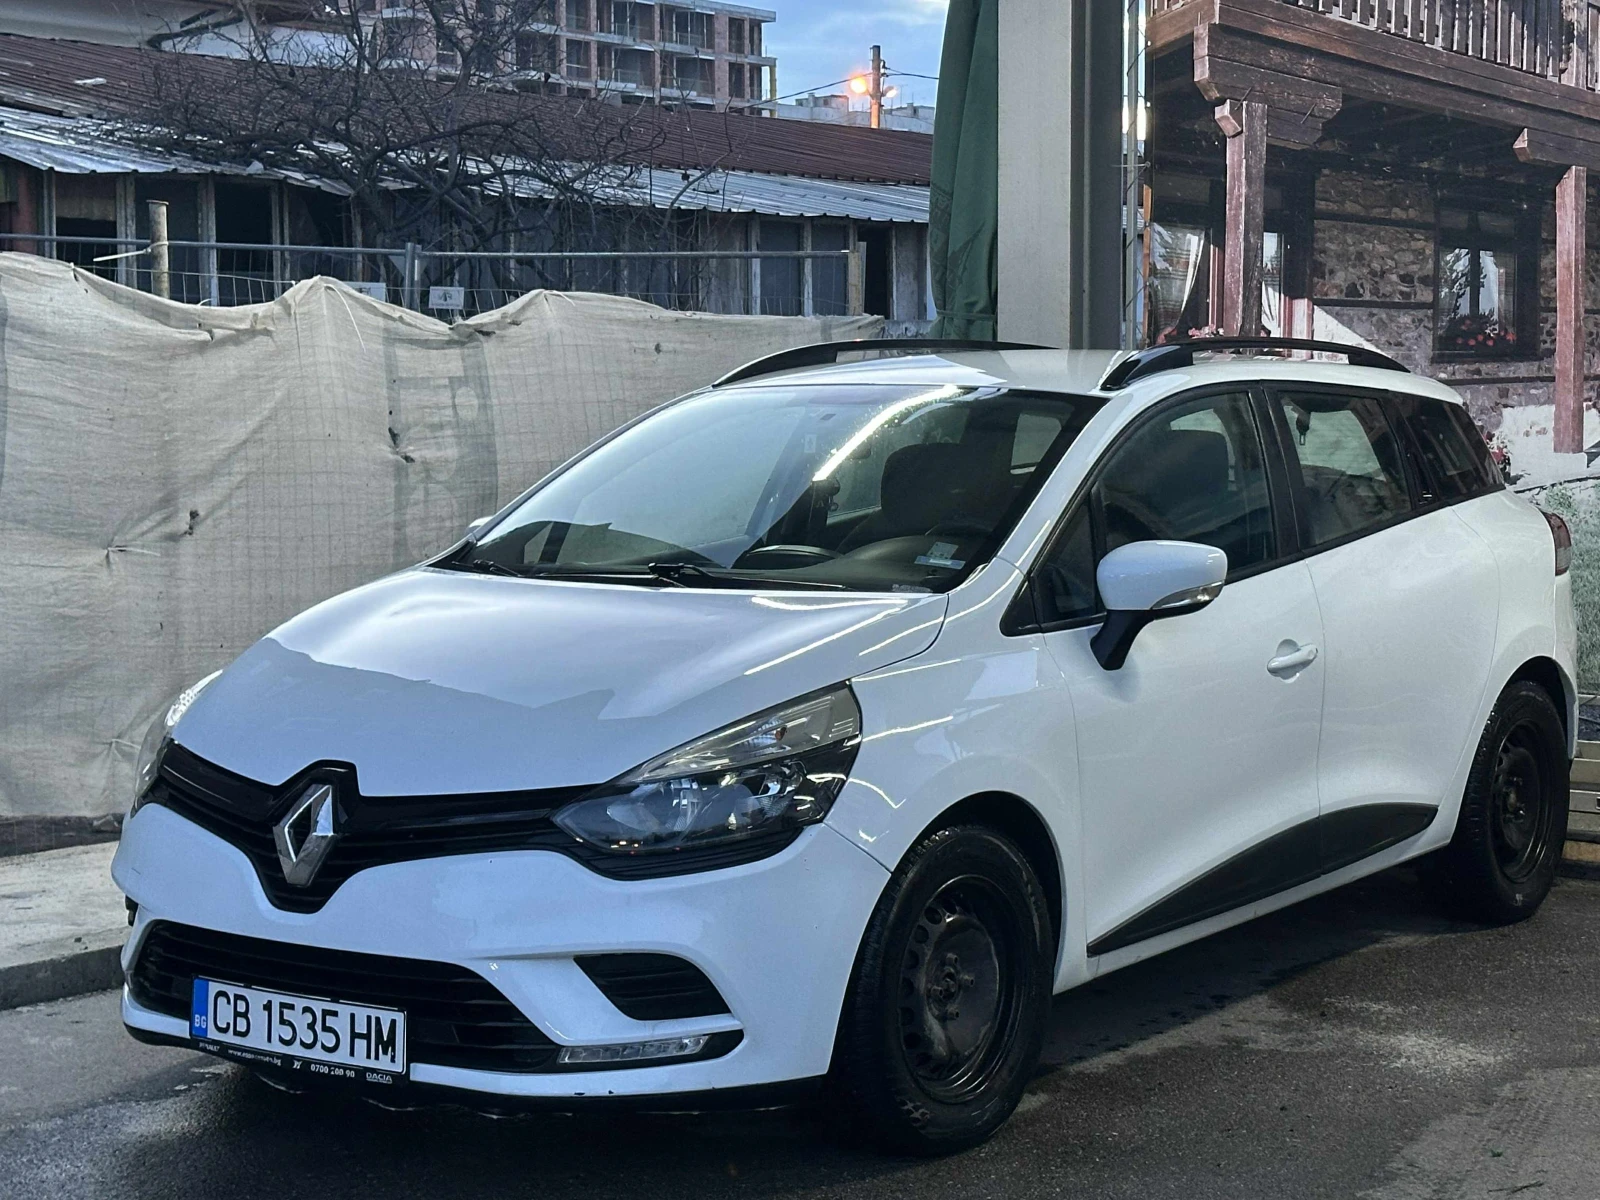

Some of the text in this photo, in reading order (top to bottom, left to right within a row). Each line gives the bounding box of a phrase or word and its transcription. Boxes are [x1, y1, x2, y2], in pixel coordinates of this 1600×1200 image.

[194, 1014, 207, 1029] BG
[212, 990, 397, 1064] CB 1535 HM
[310, 1063, 329, 1074] 0700
[345, 1070, 355, 1078] 90
[365, 1072, 392, 1082] DACIA
